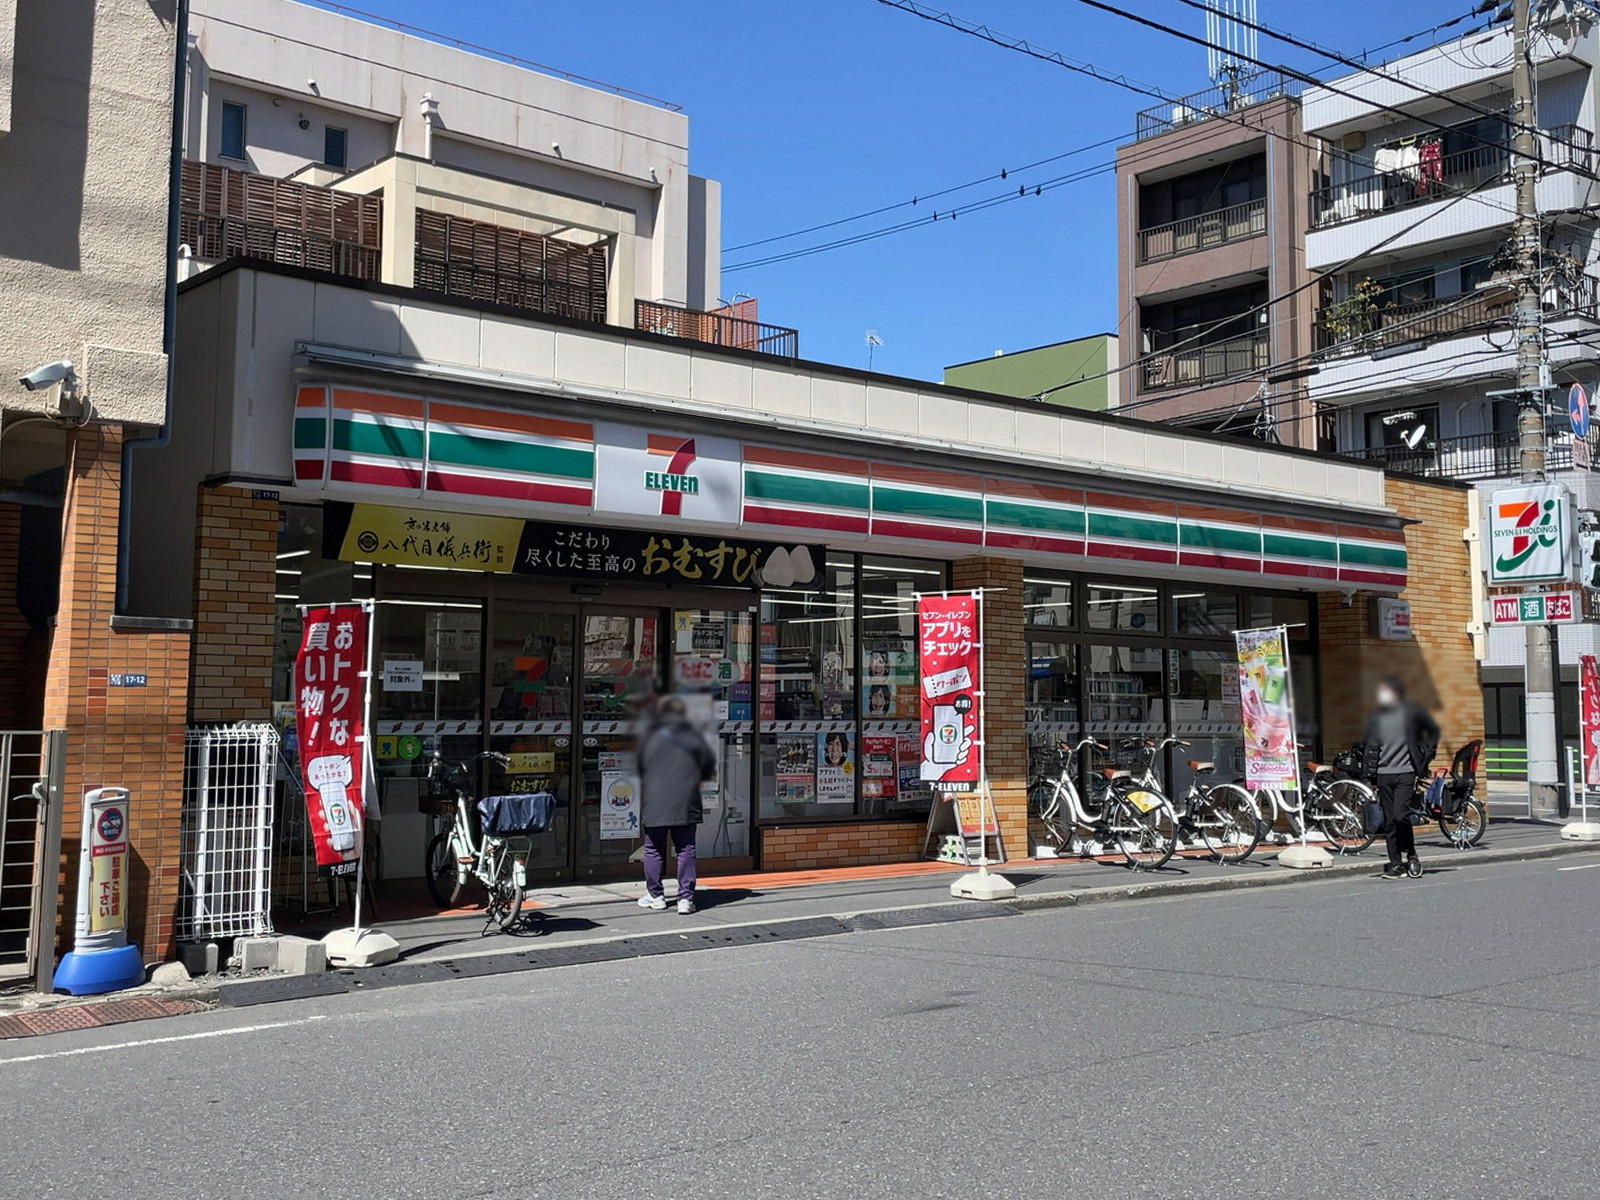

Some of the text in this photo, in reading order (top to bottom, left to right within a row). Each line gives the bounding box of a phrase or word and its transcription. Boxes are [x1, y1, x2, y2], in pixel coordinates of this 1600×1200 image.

[646, 433, 696, 515] 7
[554, 530, 611, 551] こだわり
[525, 548, 636, 573] 尽くした至高の
[641, 536, 762, 583] おむすび
[1496, 598, 1571, 619] ATM 酒 たばこ
[922, 620, 972, 639] アプリを
[922, 639, 972, 657] チェック
[125, 676, 146, 684] 17-12
[681, 661, 732, 679] たばこ 酒
[329, 621, 354, 746] おトクな
[936, 674, 967, 689] クーポン
[1250, 762, 1290, 775] Smoothie
[99, 881, 110, 918] 下さい
